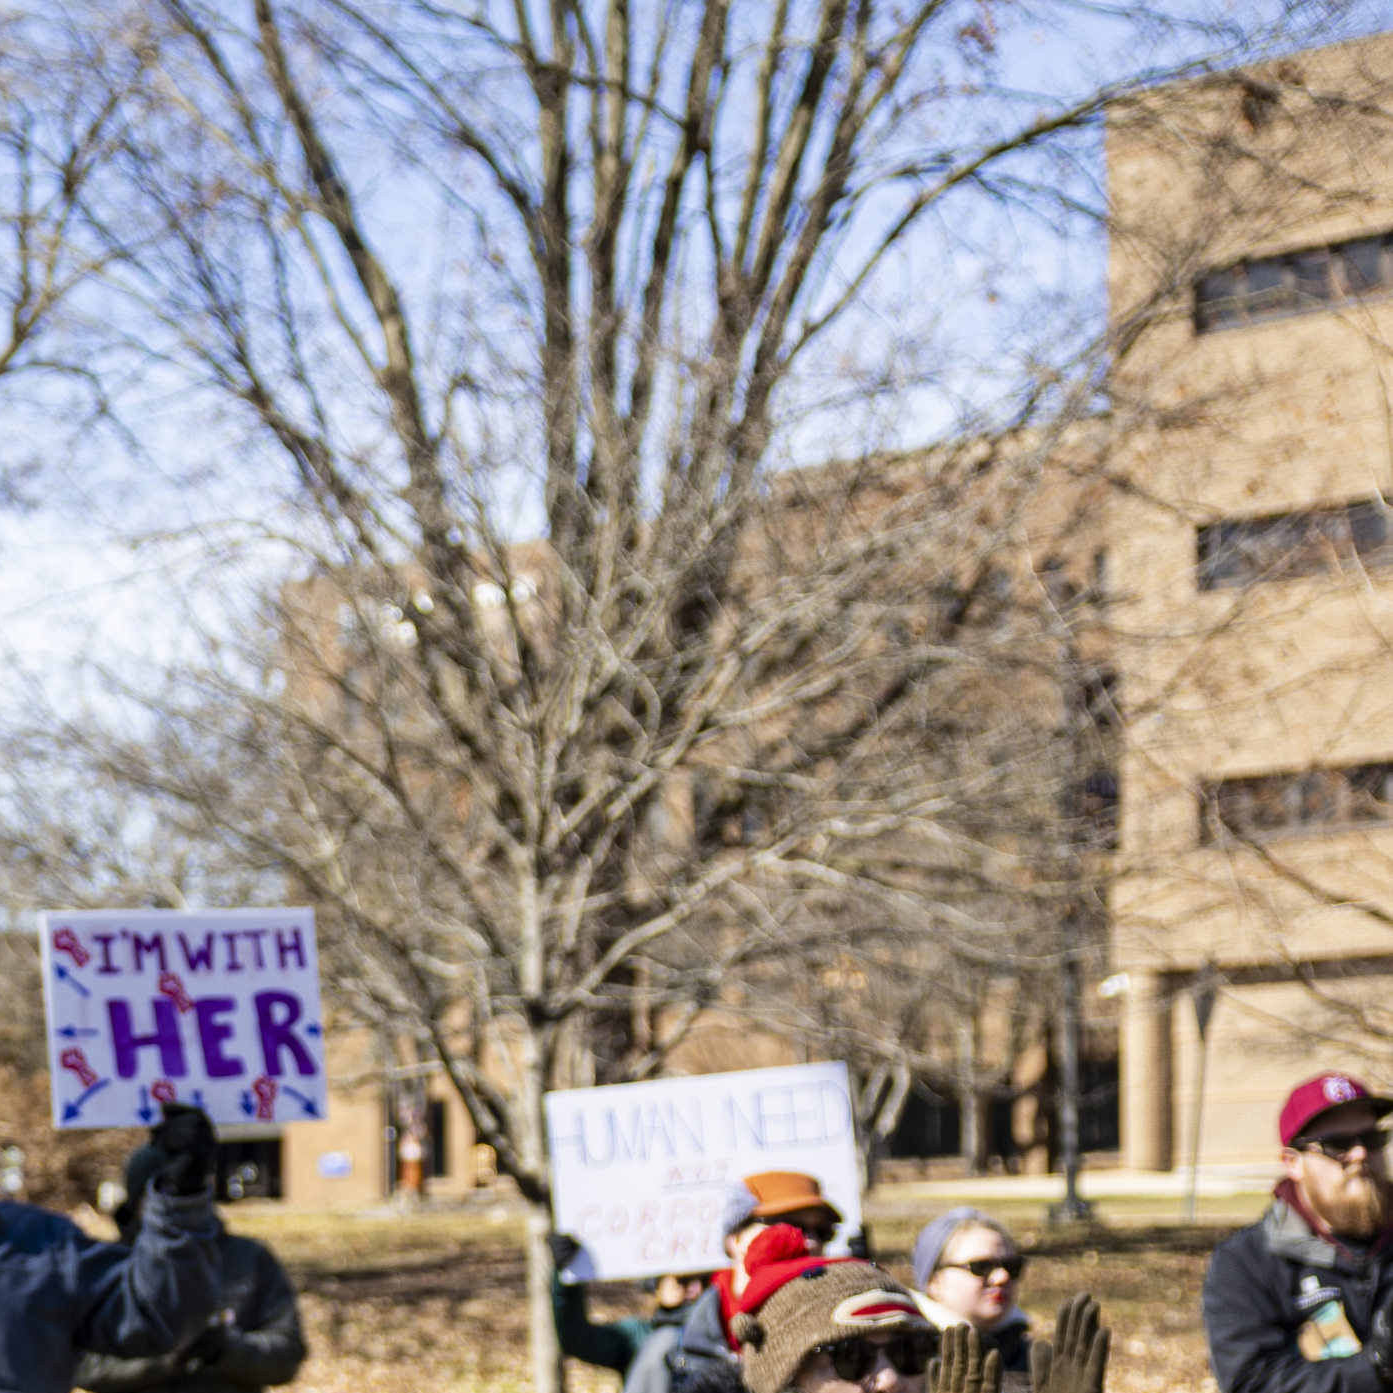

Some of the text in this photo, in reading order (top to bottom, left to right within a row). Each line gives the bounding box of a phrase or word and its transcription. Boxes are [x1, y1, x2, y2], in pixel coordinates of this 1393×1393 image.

[92, 927, 307, 974] I'M WITH
[107, 989, 318, 1079] HER
[552, 1079, 853, 1167] HUMAN NEED
[577, 1197, 723, 1239] CORPO
